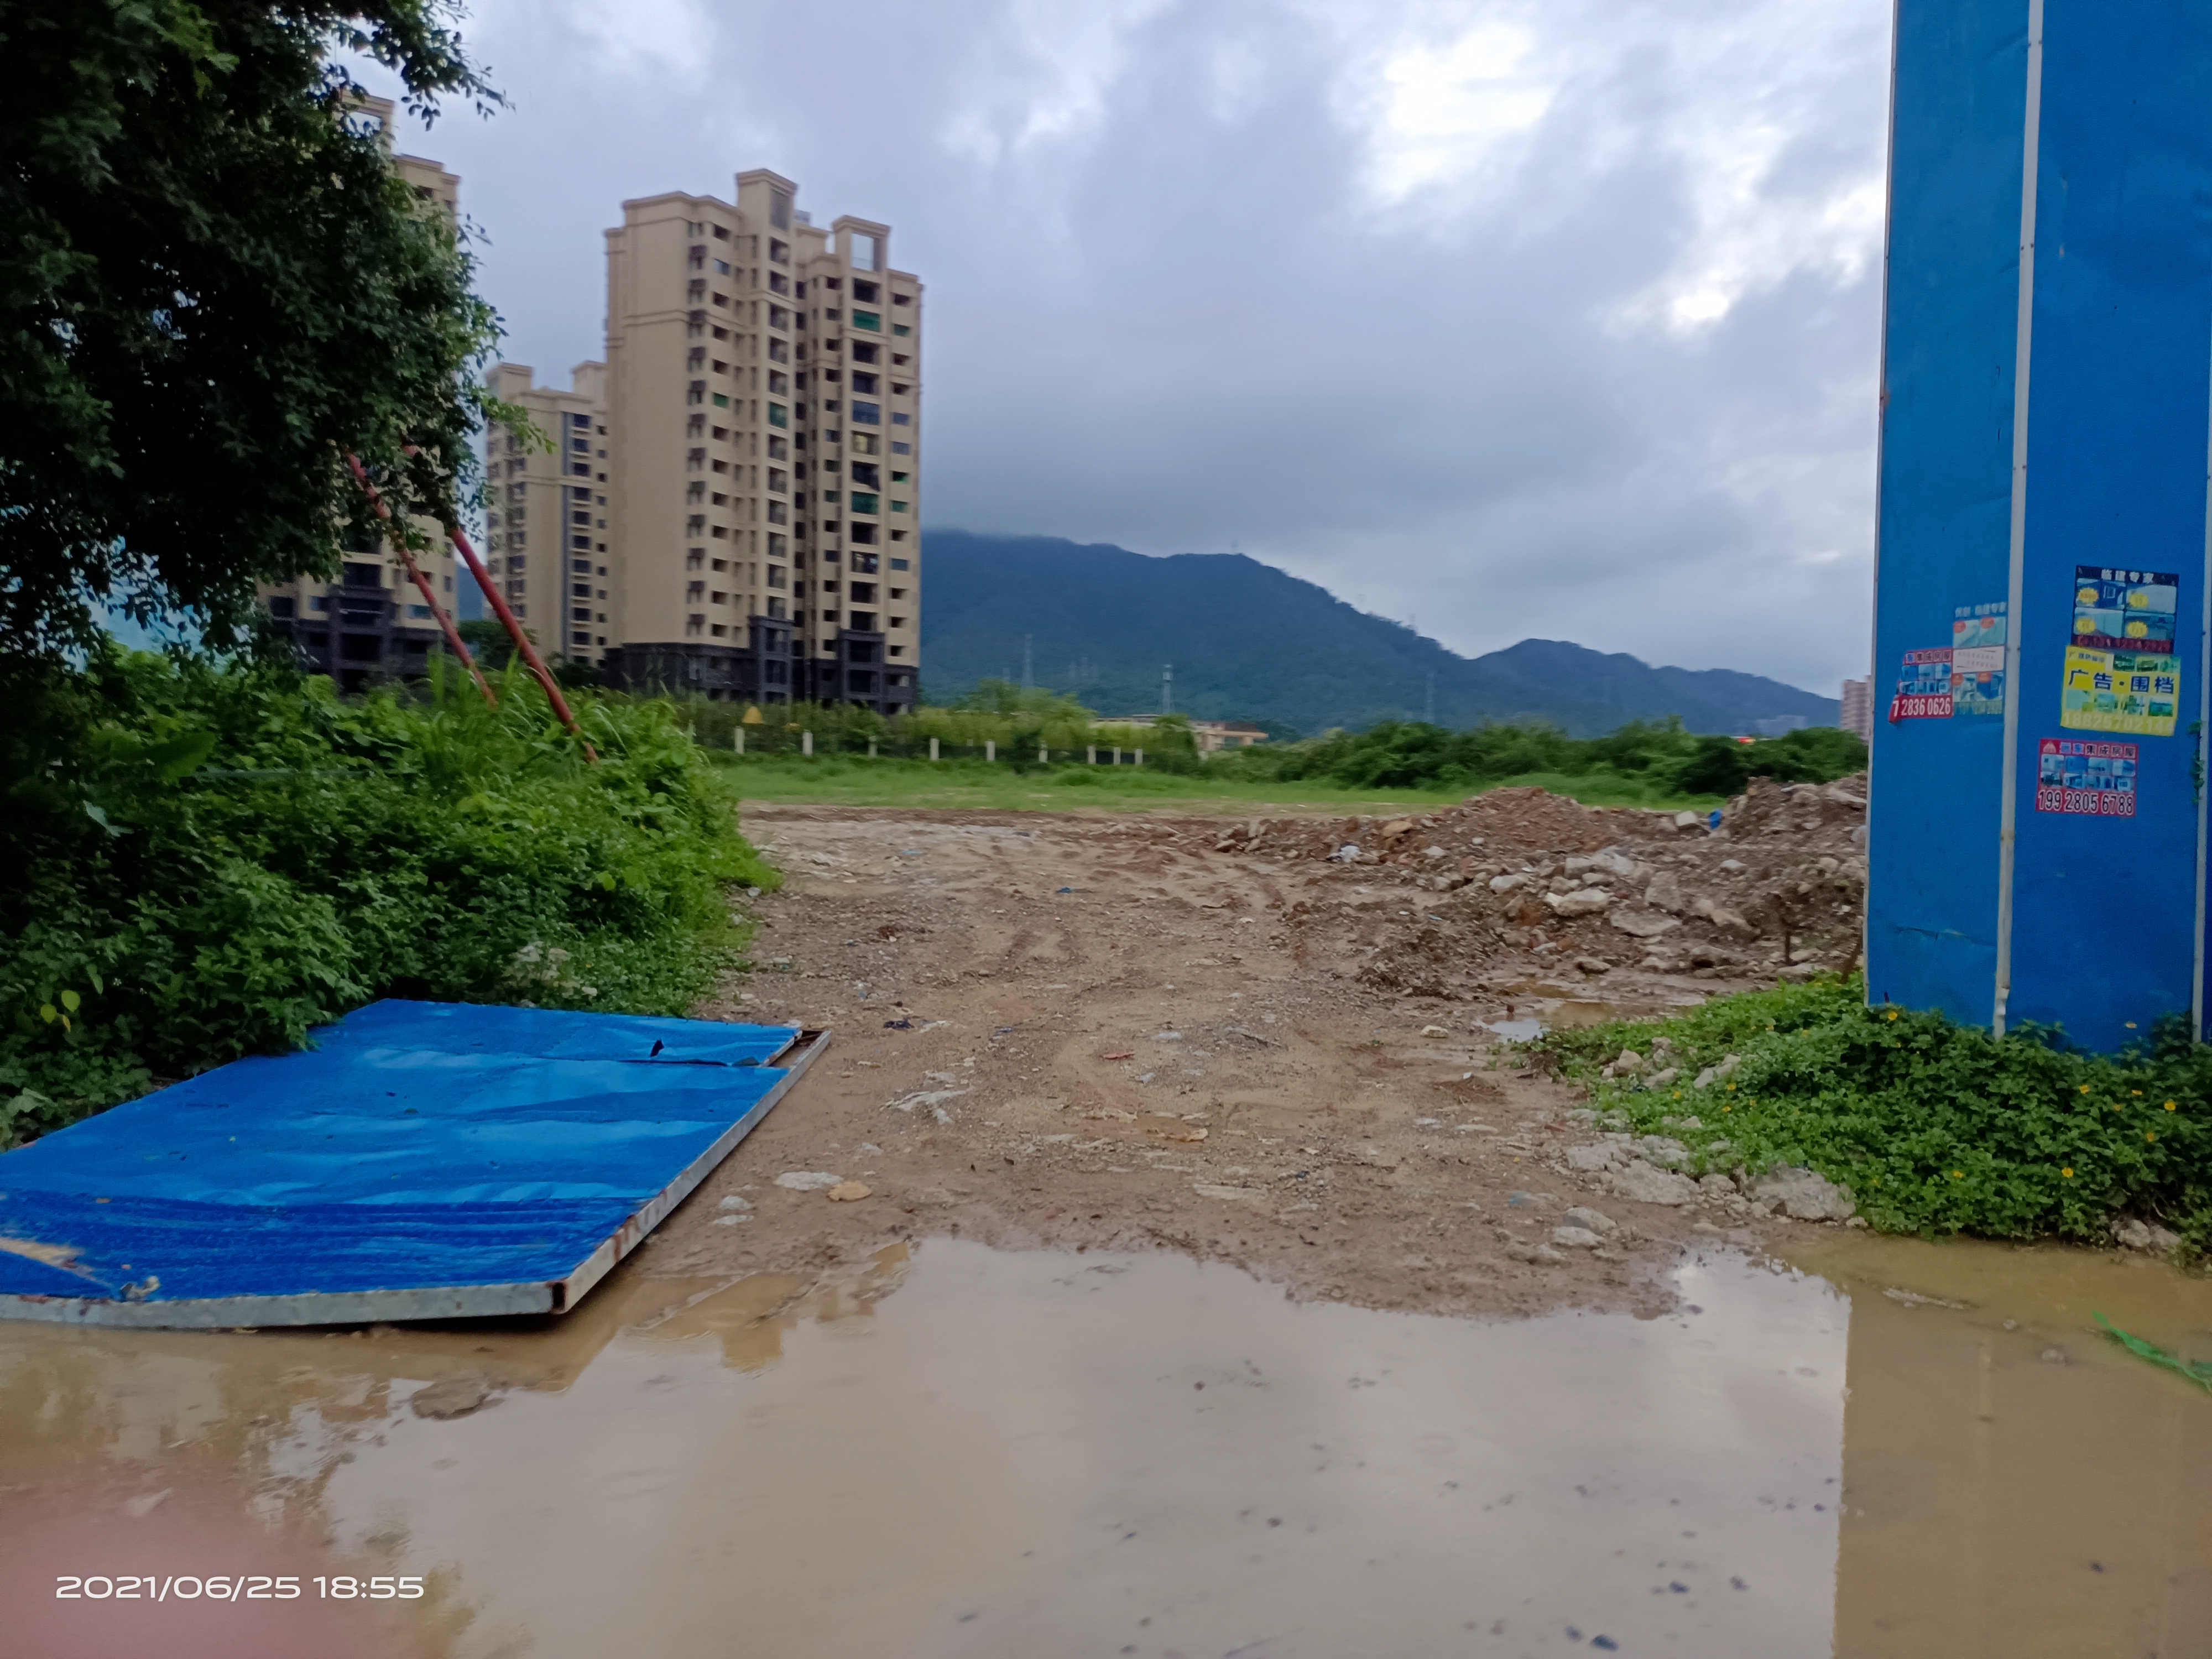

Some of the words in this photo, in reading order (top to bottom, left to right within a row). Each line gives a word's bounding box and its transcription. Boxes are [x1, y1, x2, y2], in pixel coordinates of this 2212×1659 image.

[1901, 697, 1926, 716] 2836
[1927, 697, 1951, 715] 0626
[2038, 789, 2062, 811] 199
[2064, 791, 2098, 813] 2805
[2102, 793, 2133, 816] 6788
